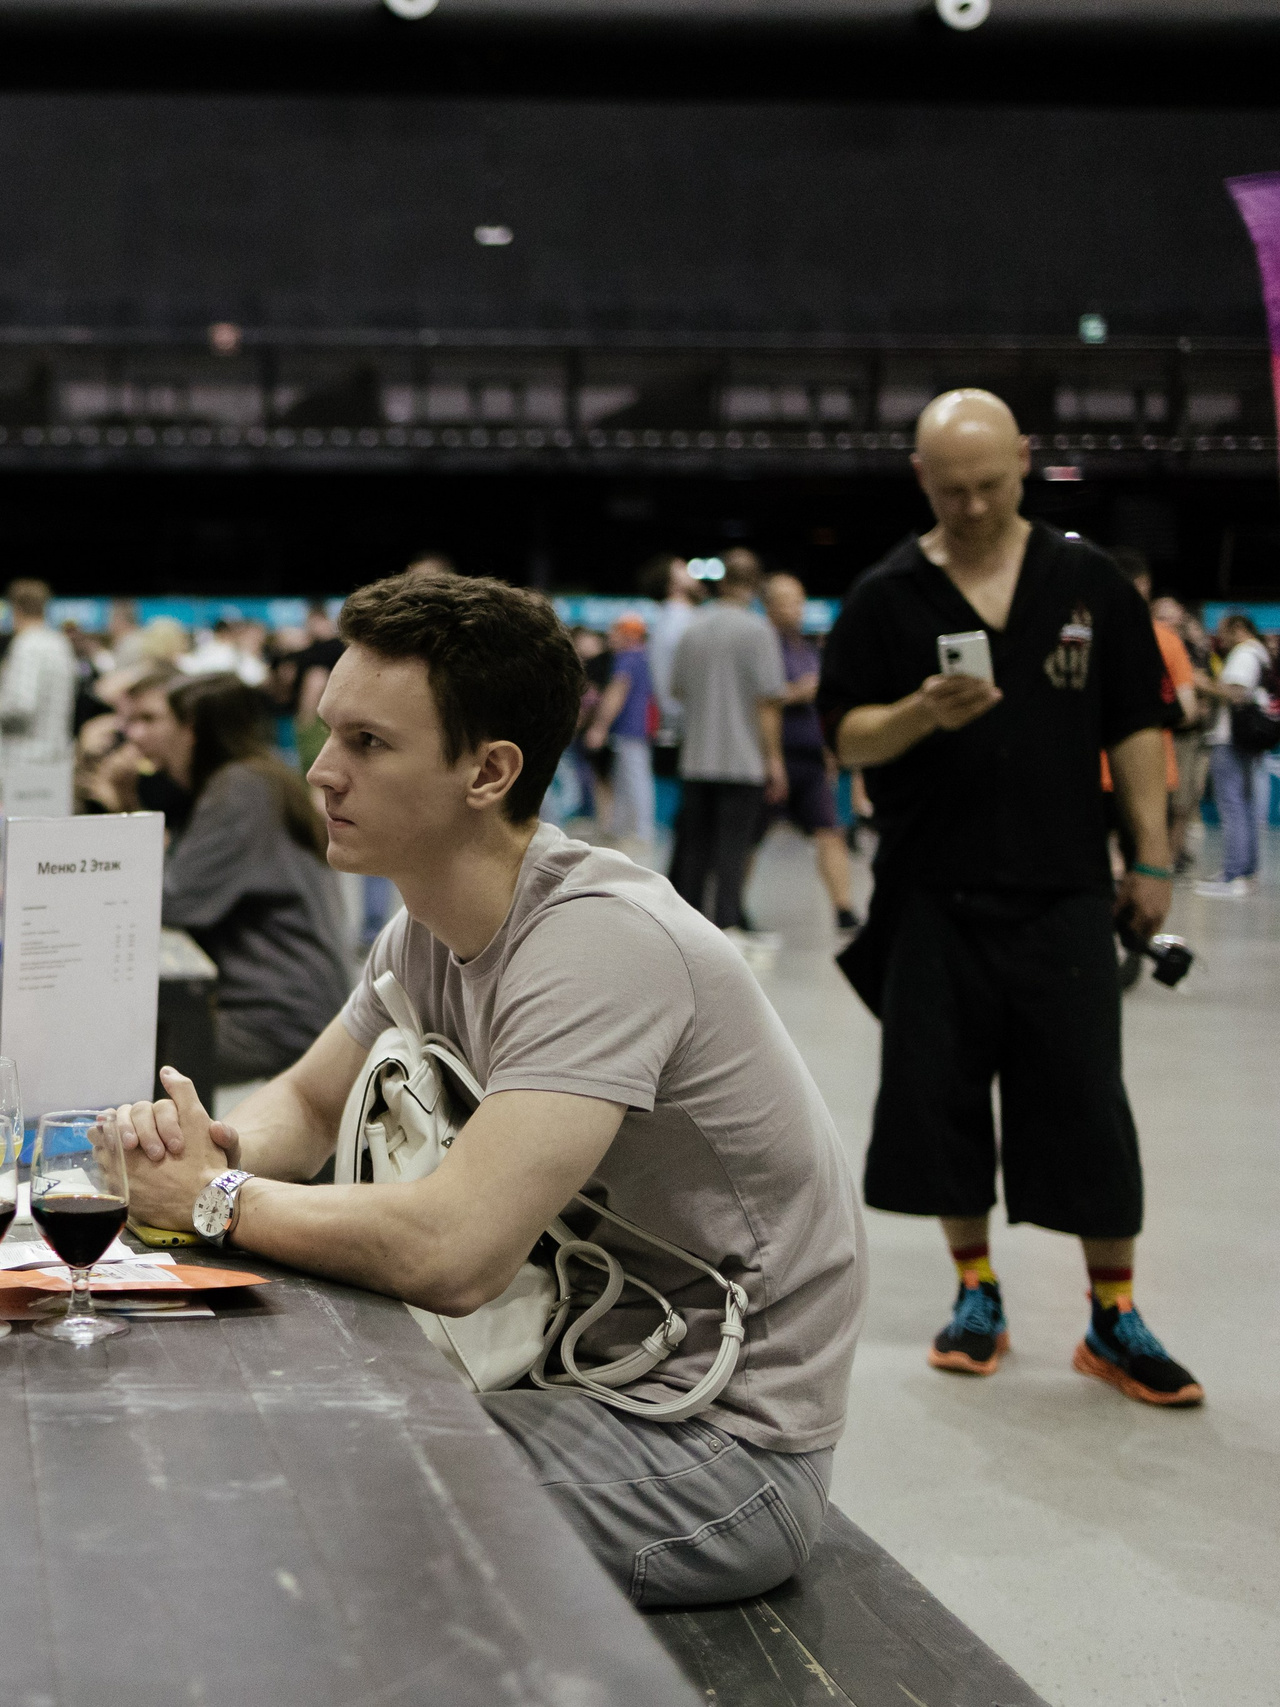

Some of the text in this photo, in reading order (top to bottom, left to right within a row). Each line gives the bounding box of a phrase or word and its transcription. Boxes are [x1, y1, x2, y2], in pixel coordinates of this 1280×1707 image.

[38, 859, 121, 875] Меню 2 Этаж
